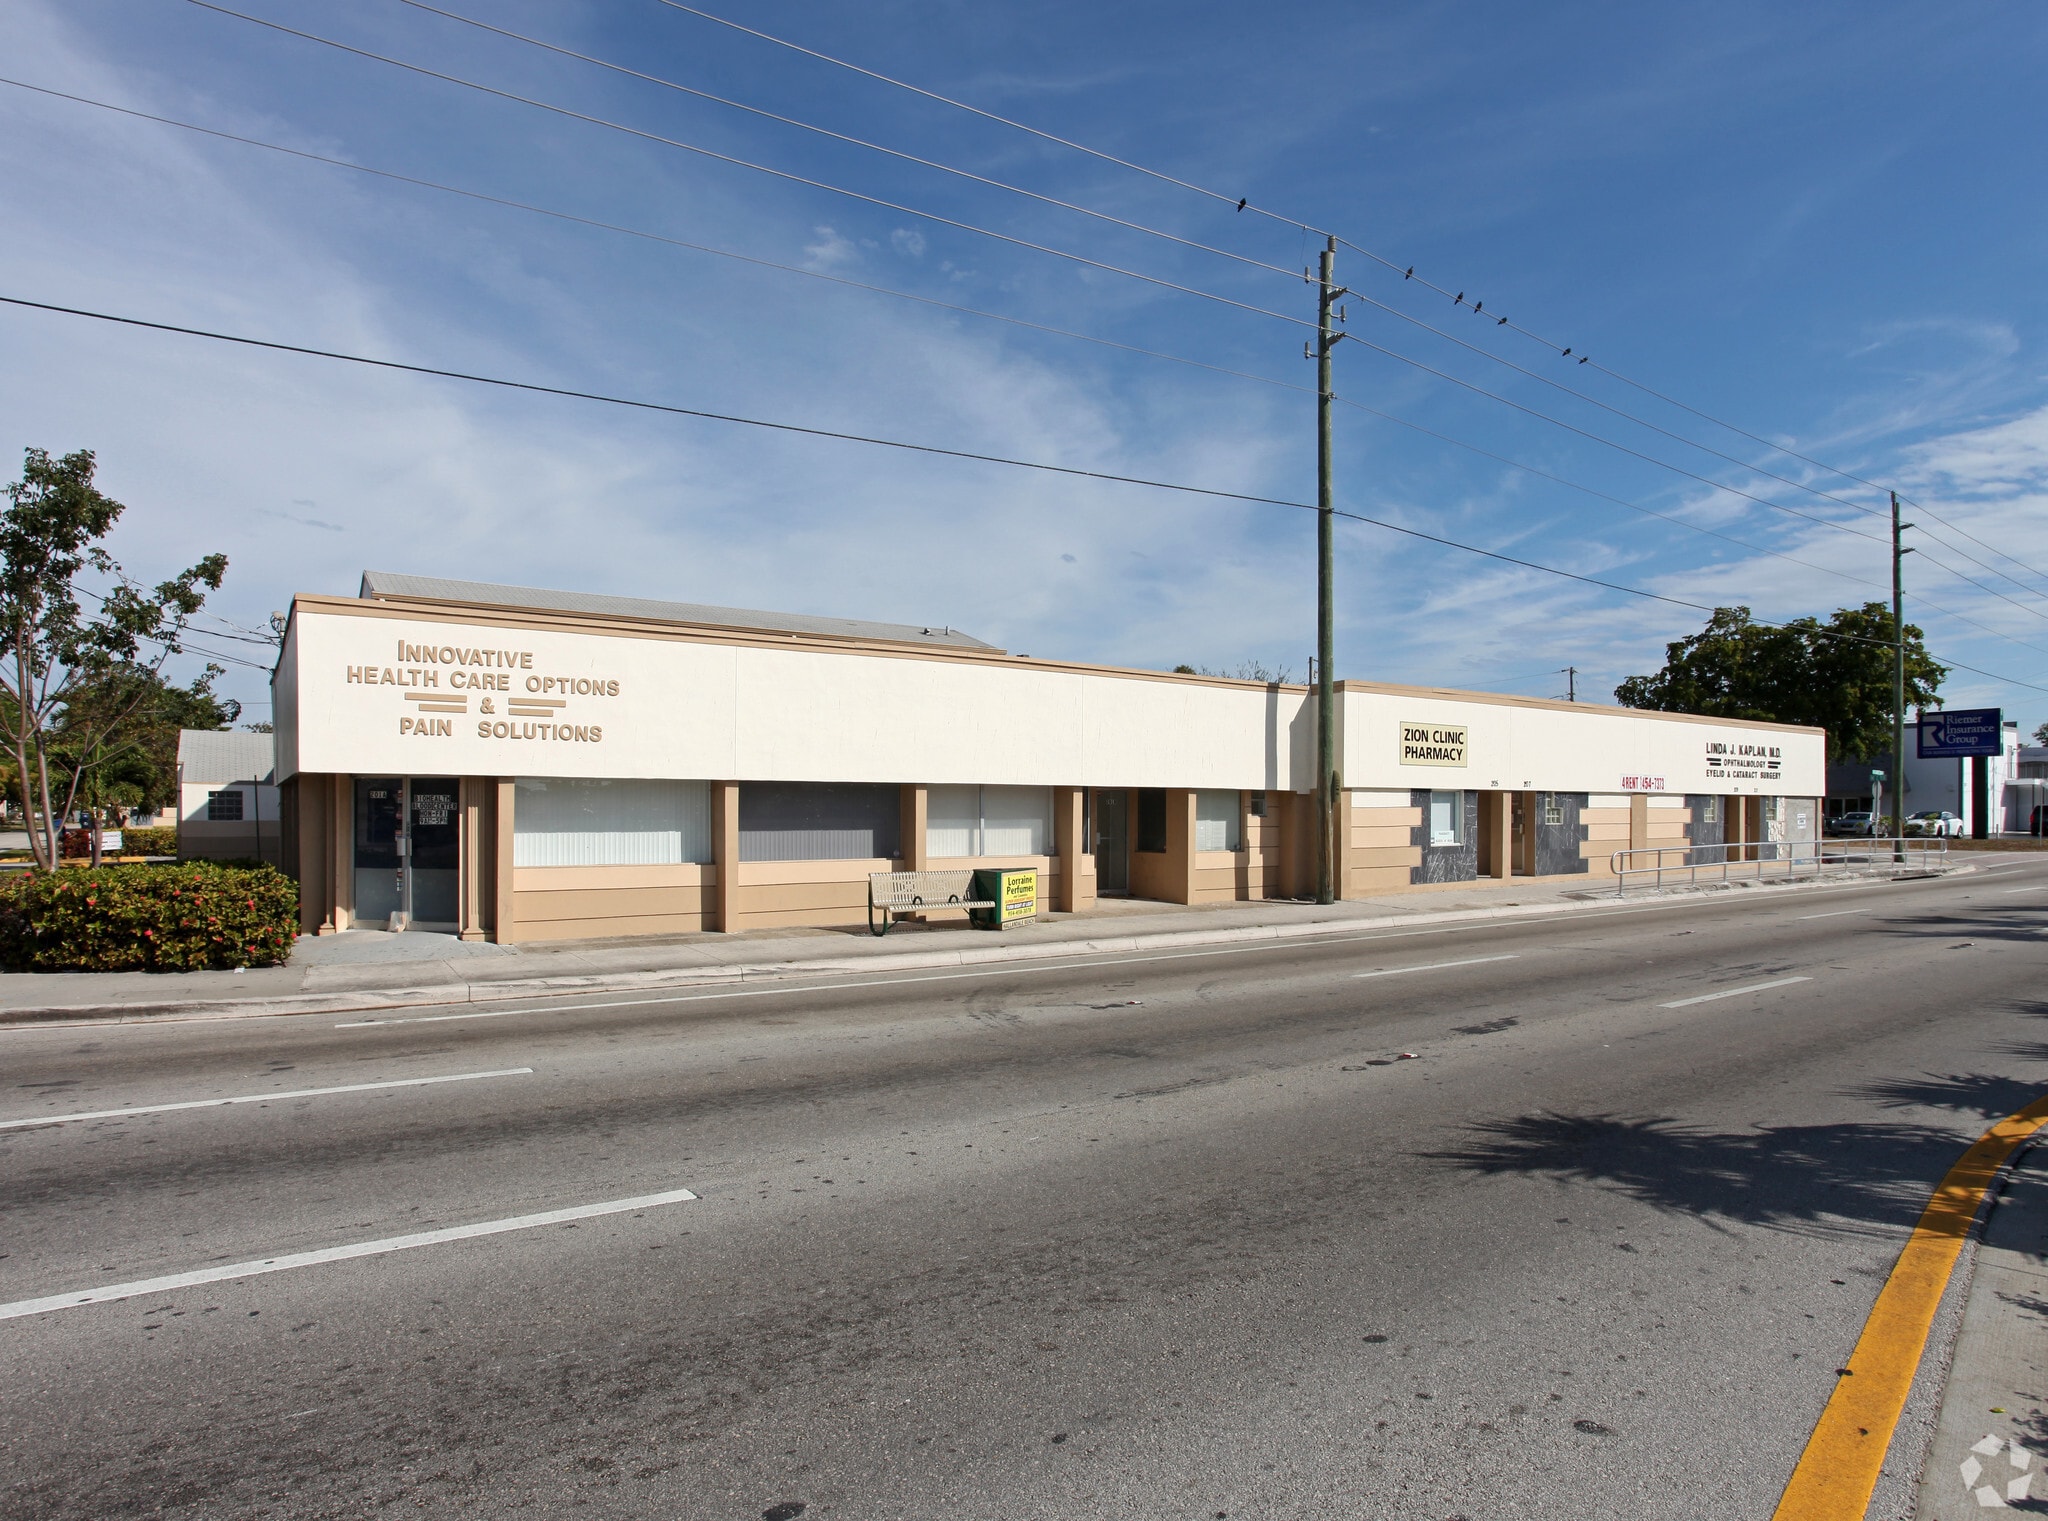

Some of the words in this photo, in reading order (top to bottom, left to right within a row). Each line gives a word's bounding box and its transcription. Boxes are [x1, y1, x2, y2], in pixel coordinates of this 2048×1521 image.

[398, 640, 533, 669] INNOVATIVE
[347, 665, 438, 687] HEALTH
[450, 671, 510, 691] CARE
[526, 675, 620, 696] OPTIONS
[480, 697, 495, 714] &
[1946, 715, 1983, 725] Riemer
[400, 717, 452, 736] PAIN
[478, 721, 602, 742] SOLUTIONS
[1946, 725, 1995, 735] Insurance
[1404, 728, 1429, 742] ZION
[1433, 730, 1464, 745] CLINIC
[1946, 734, 1978, 745] Group
[1405, 746, 1463, 761] PHARMACY
[1706, 742, 1727, 754] LINDA
[1730, 744, 1736, 755] J.
[1739, 745, 1767, 758] KAPLAN,
[1769, 747, 1782, 758] M.D.
[1724, 759, 1766, 768] OPHTHALMOLOGY
[1706, 769, 1725, 778] EYELID
[1733, 770, 1758, 779] CATARACT
[1760, 771, 1781, 780] SURGERY
[1008, 875, 1032, 886] Lorraine
[1007, 885, 1033, 895] Perfumes
